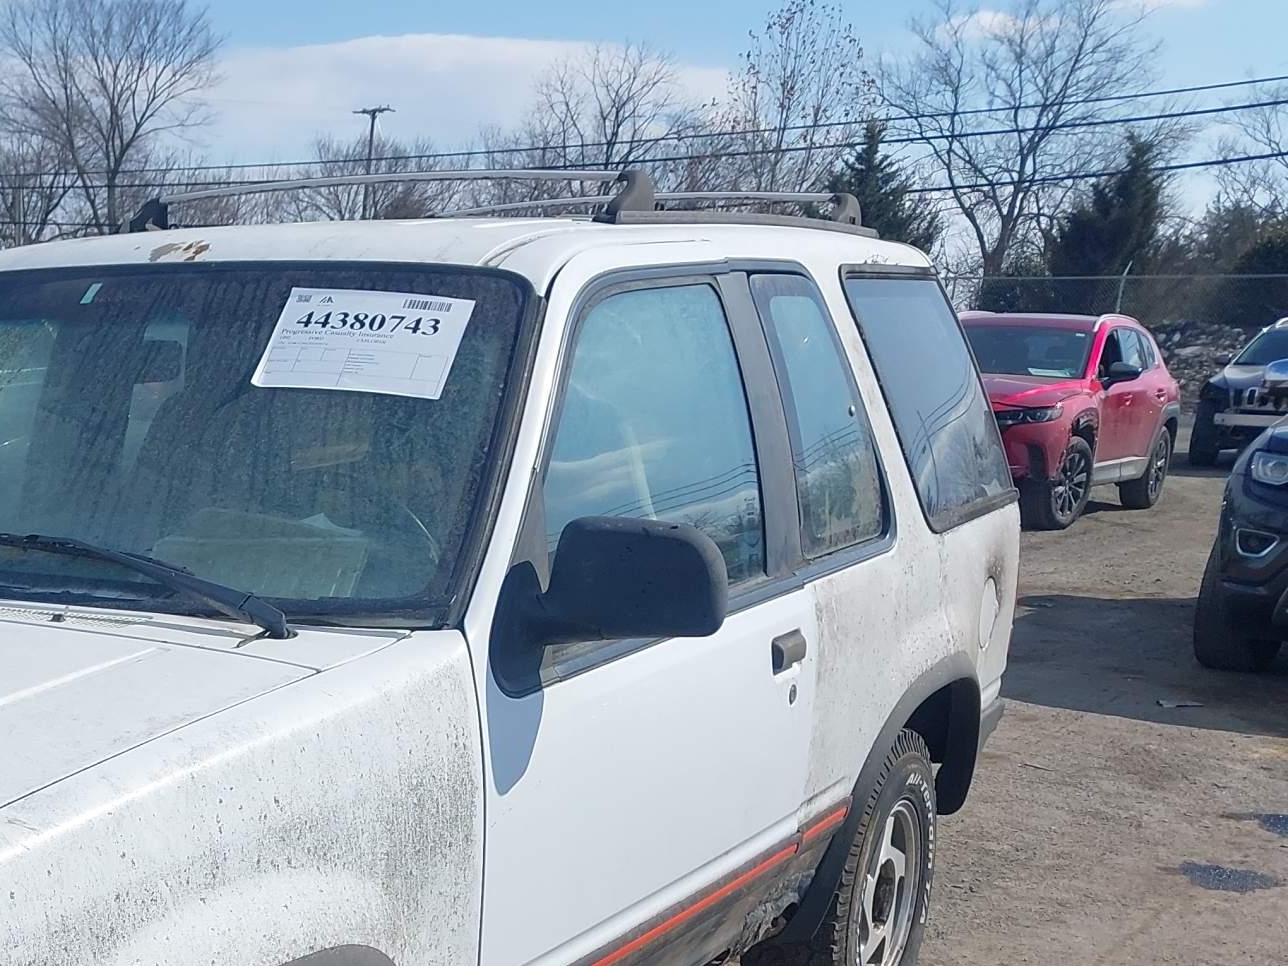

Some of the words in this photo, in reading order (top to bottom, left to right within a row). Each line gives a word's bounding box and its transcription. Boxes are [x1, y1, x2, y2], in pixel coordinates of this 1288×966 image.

[296, 310, 441, 336] 44380743
[281, 328, 323, 336] Progressive
[325, 329, 356, 338] Casualty
[358, 331, 394, 339] Insurance
